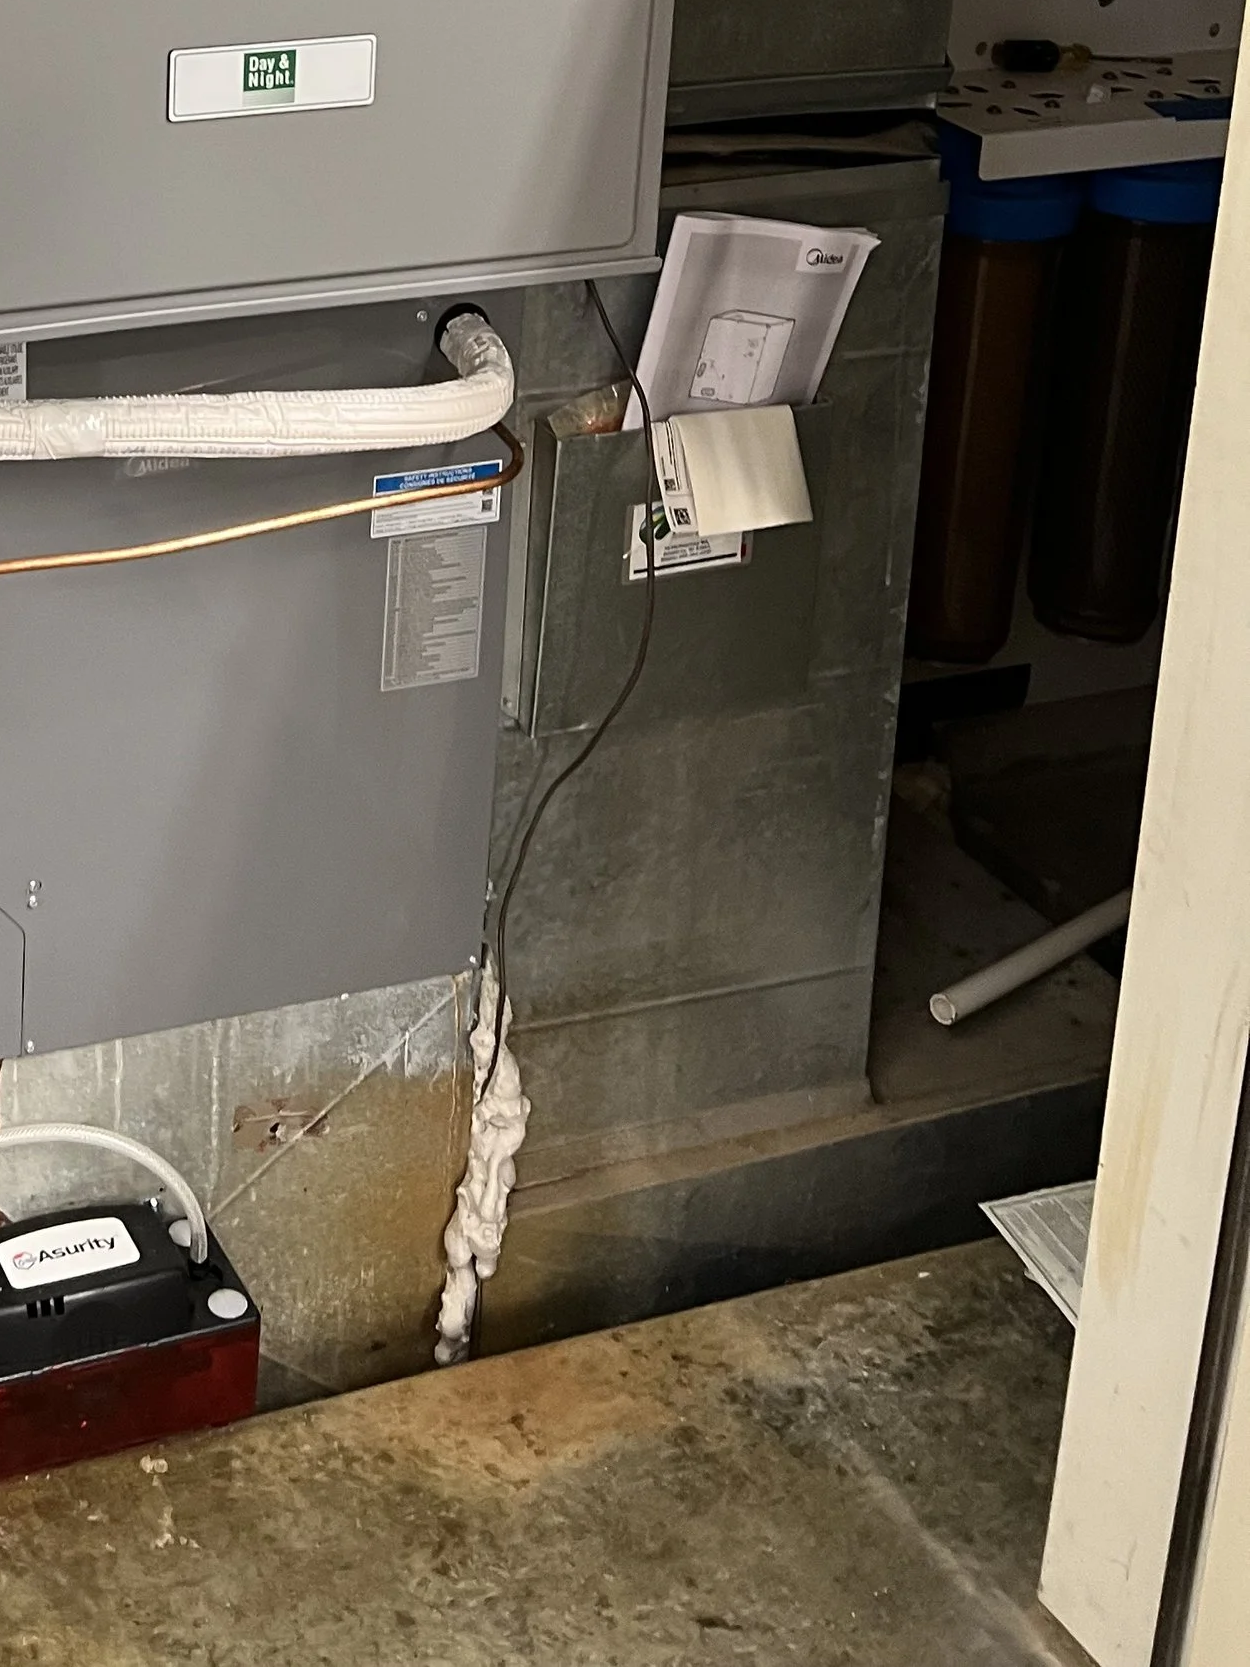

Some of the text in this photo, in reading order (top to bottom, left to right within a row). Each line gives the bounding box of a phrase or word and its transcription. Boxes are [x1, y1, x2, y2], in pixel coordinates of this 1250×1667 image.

[249, 53, 290, 74] Day &
[248, 69, 290, 89] Night
[38, 1234, 116, 1263] Asurity
